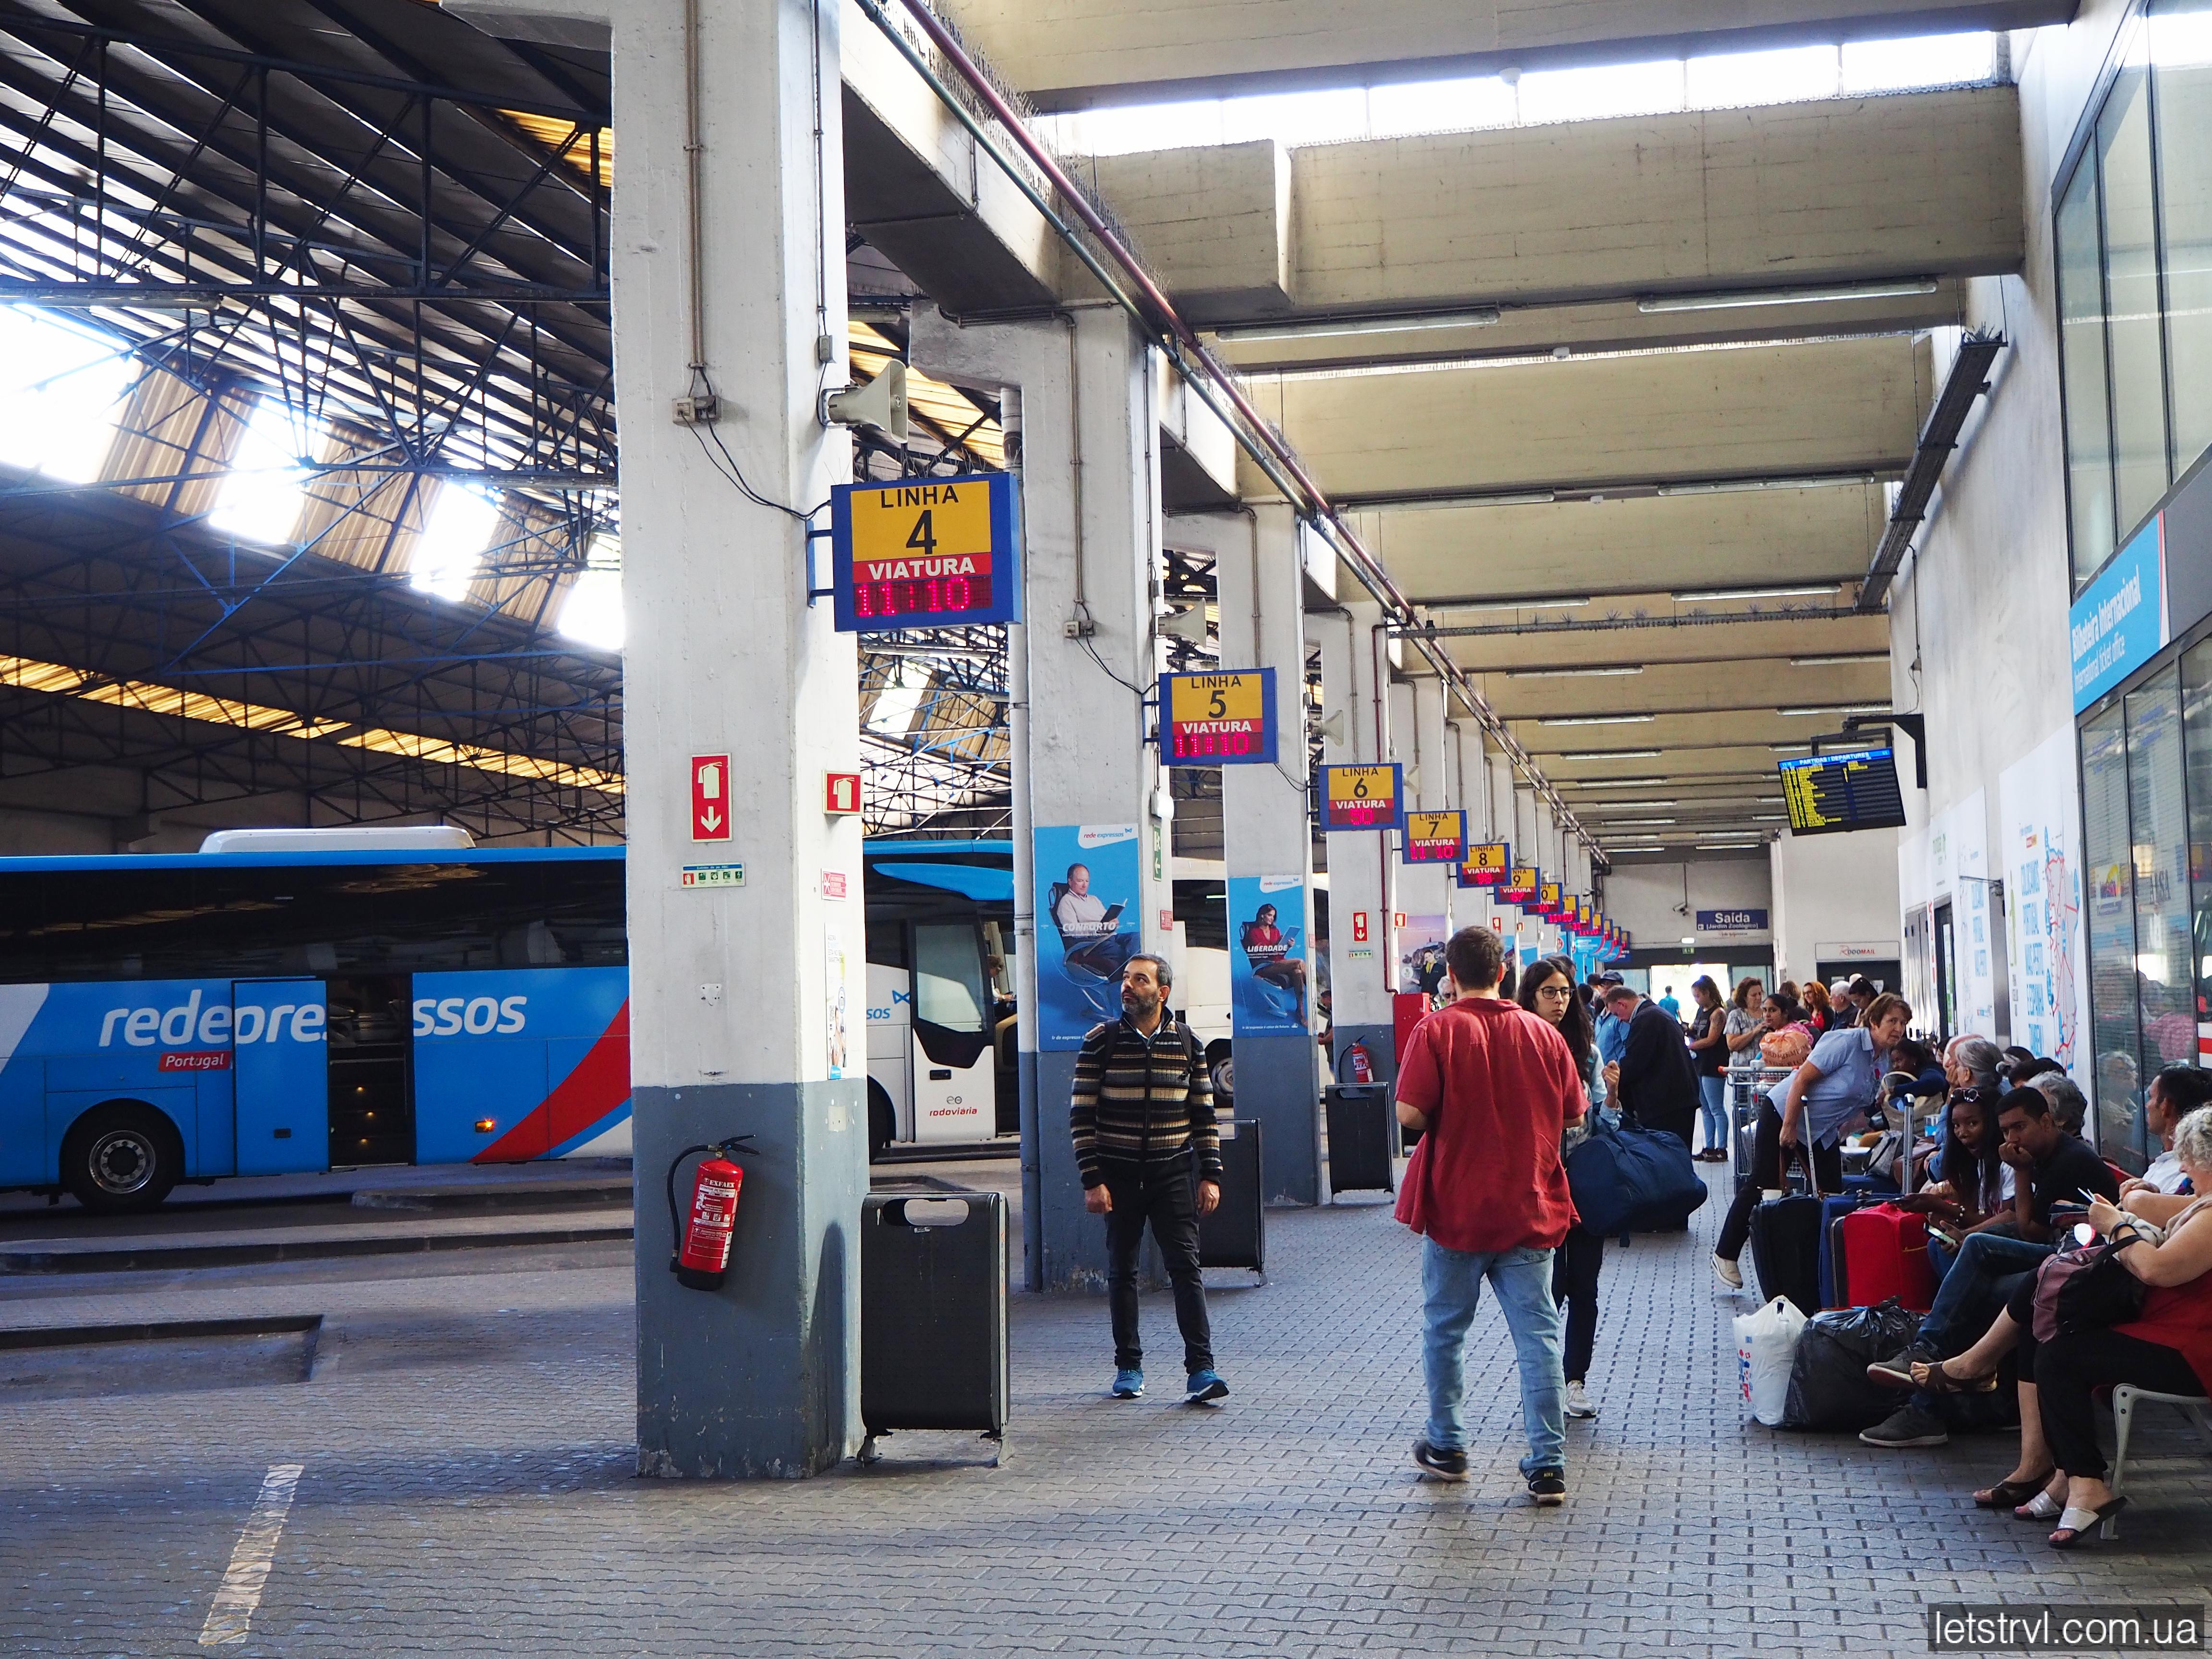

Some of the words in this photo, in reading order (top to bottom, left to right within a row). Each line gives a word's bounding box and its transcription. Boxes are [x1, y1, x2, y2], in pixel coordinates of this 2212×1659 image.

[881, 485, 959, 508] LINHA
[906, 510, 937, 554] 4
[868, 557, 975, 580] VIATURA
[856, 577, 970, 617] 11:10
[2072, 611, 2099, 663] Bilheteira
[2098, 564, 2141, 637] Internacional
[2099, 641, 2112, 673] ticket
[2112, 630, 2125, 662] office
[1191, 675, 1242, 689] LINHA
[1208, 690, 1226, 719] 5
[1182, 721, 1252, 734] VIATURA
[1175, 732, 1249, 757] 11:10
[1800, 757, 1827, 765] PARTIDAS
[1831, 752, 1869, 761] DEPARTURES
[1342, 767, 1379, 777] LINHA
[1354, 778, 1368, 798] 6
[1336, 800, 1386, 809] VIATURA
[1350, 808, 1373, 825] 50
[1419, 813, 1448, 821] LINHA
[1428, 821, 1439, 837] 7
[1415, 838, 1455, 847] VIATURA
[1479, 853, 1487, 866] 8
[1513, 875, 1521, 887] 9
[1541, 889, 1548, 900] 0
[1715, 912, 1750, 923] Saída
[1062, 922, 1116, 931] CONFORTO
[166, 1056, 223, 1070] Portugal
[930, 1106, 977, 1116] rodoviária
[709, 1179, 735, 1188] EXFAEX
